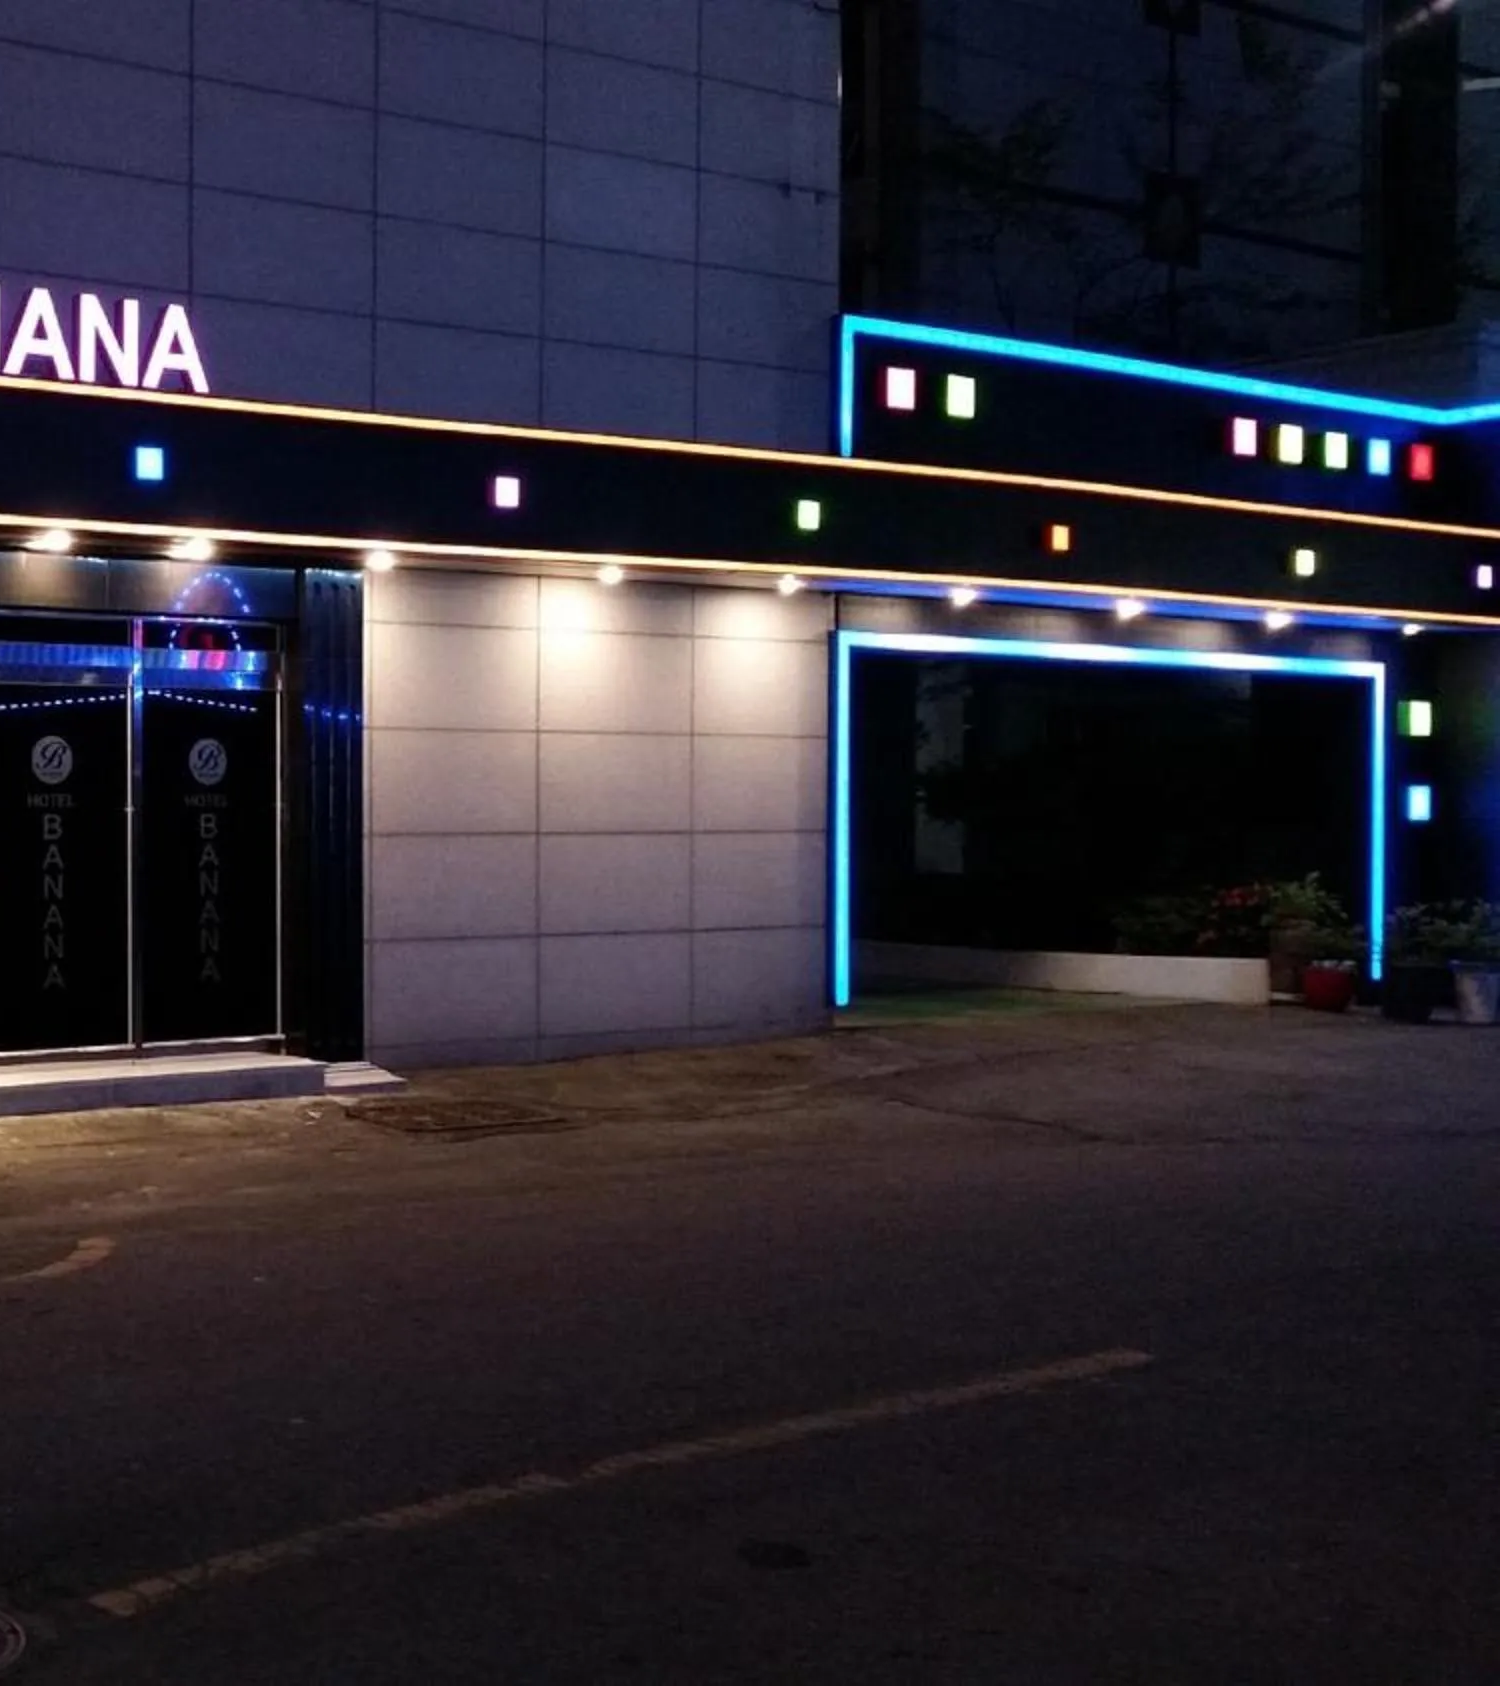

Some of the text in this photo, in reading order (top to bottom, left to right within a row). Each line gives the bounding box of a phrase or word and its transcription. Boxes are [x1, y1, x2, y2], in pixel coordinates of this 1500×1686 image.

[26, 792, 77, 809] HOTEL
[41, 812, 68, 991] BANANA
[197, 812, 222, 983] BANANA
